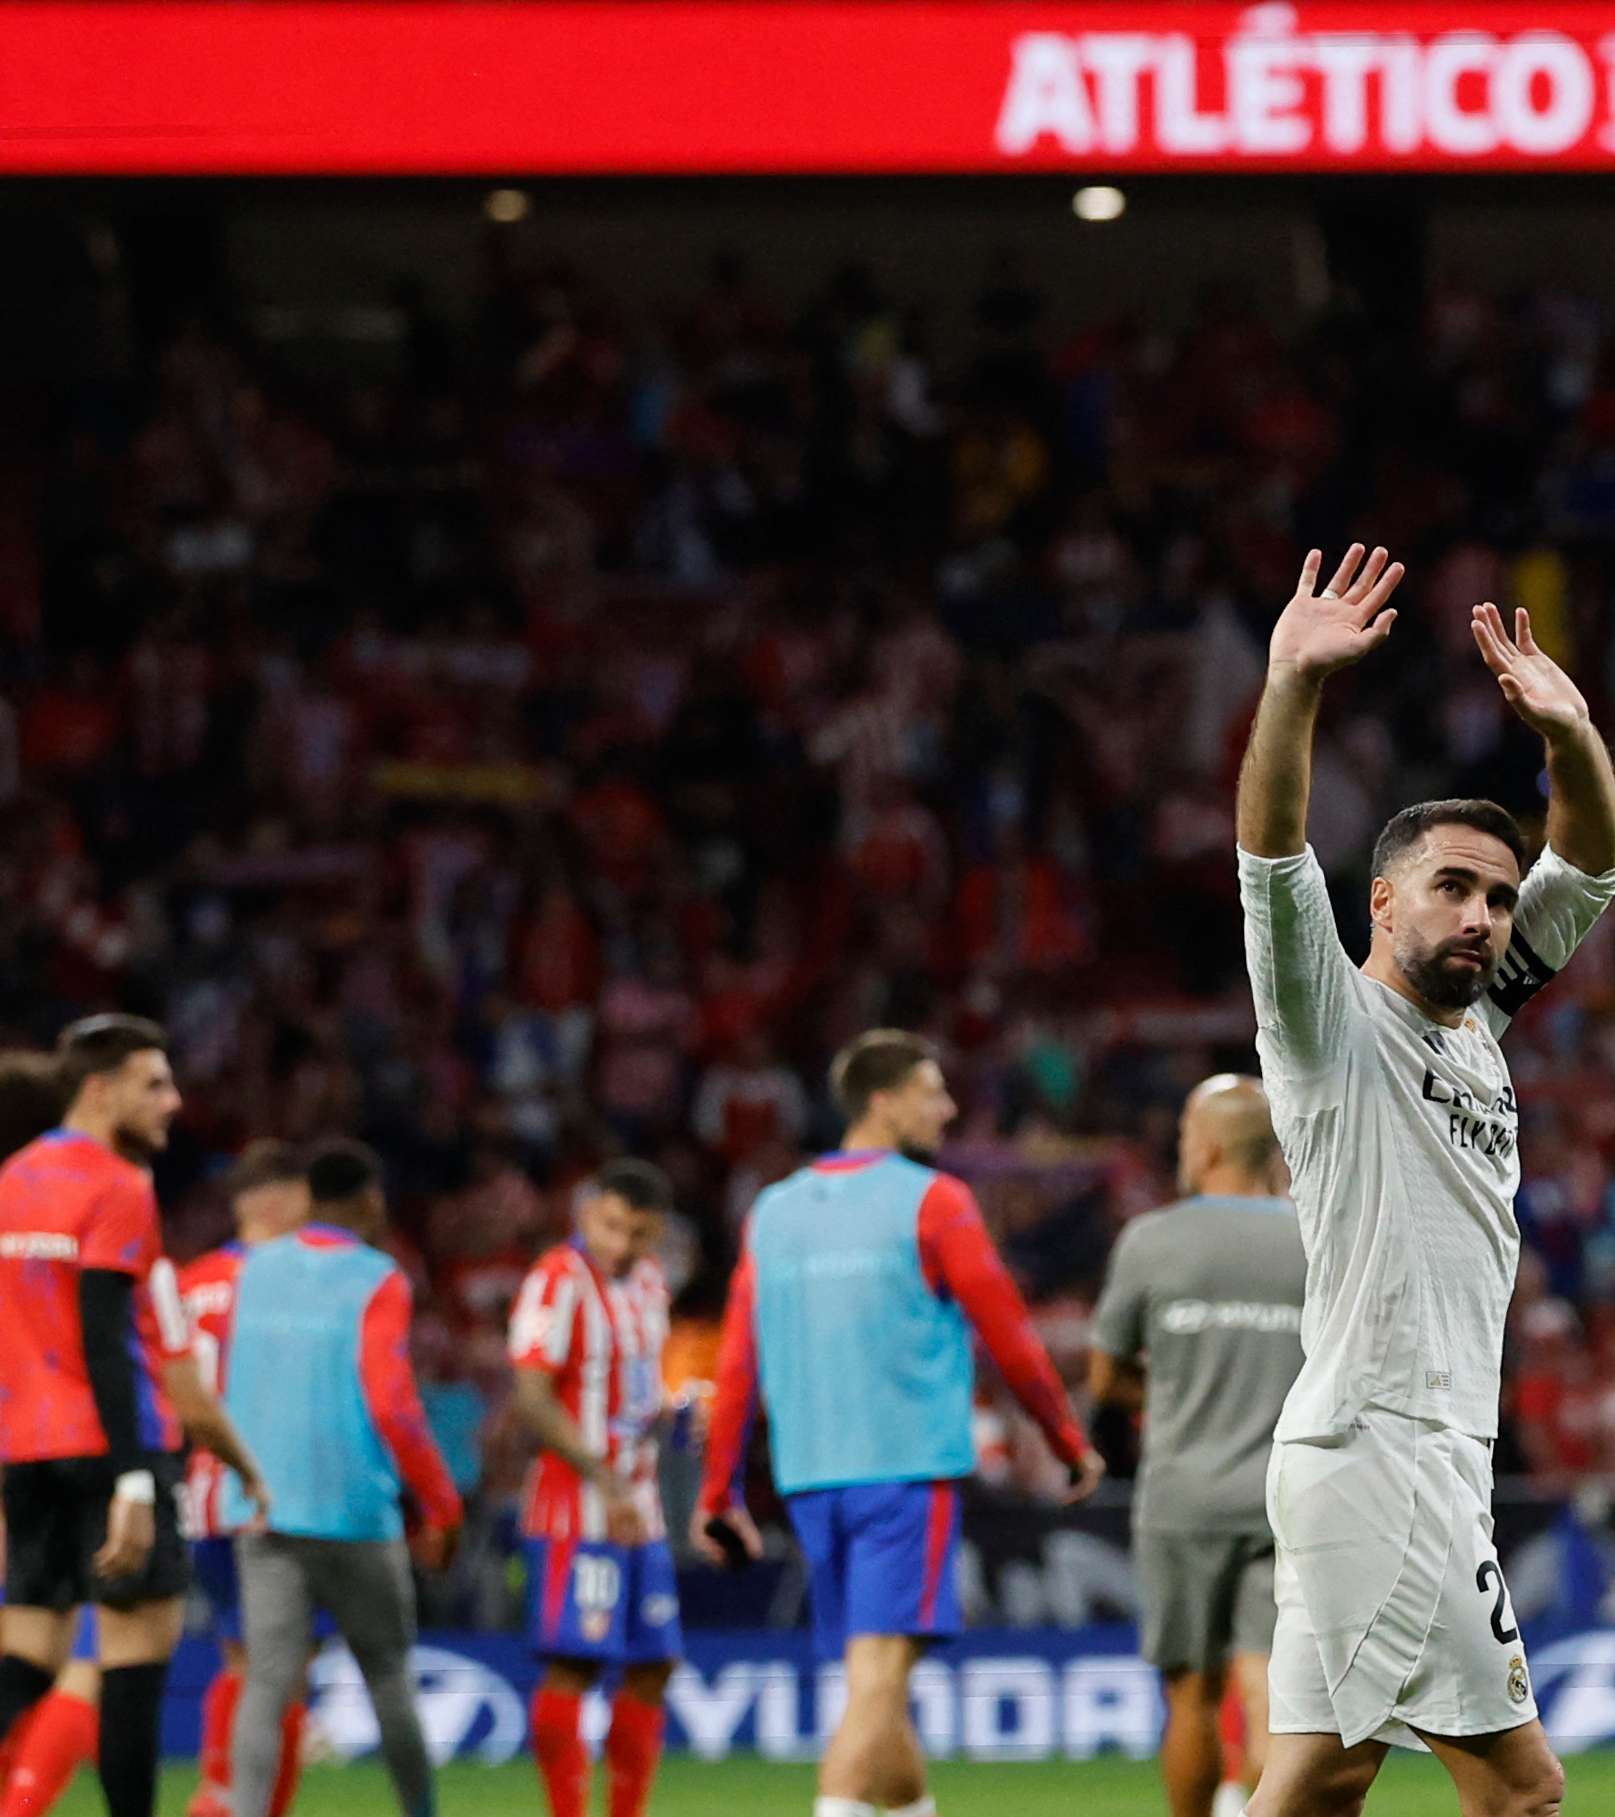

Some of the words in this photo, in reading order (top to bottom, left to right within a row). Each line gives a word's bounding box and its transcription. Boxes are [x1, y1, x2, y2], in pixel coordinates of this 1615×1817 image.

[995, 3, 1596, 155] ATLÉTICO
[1448, 1113, 1487, 1150] FLY
[1475, 1559, 1519, 1645] 2
